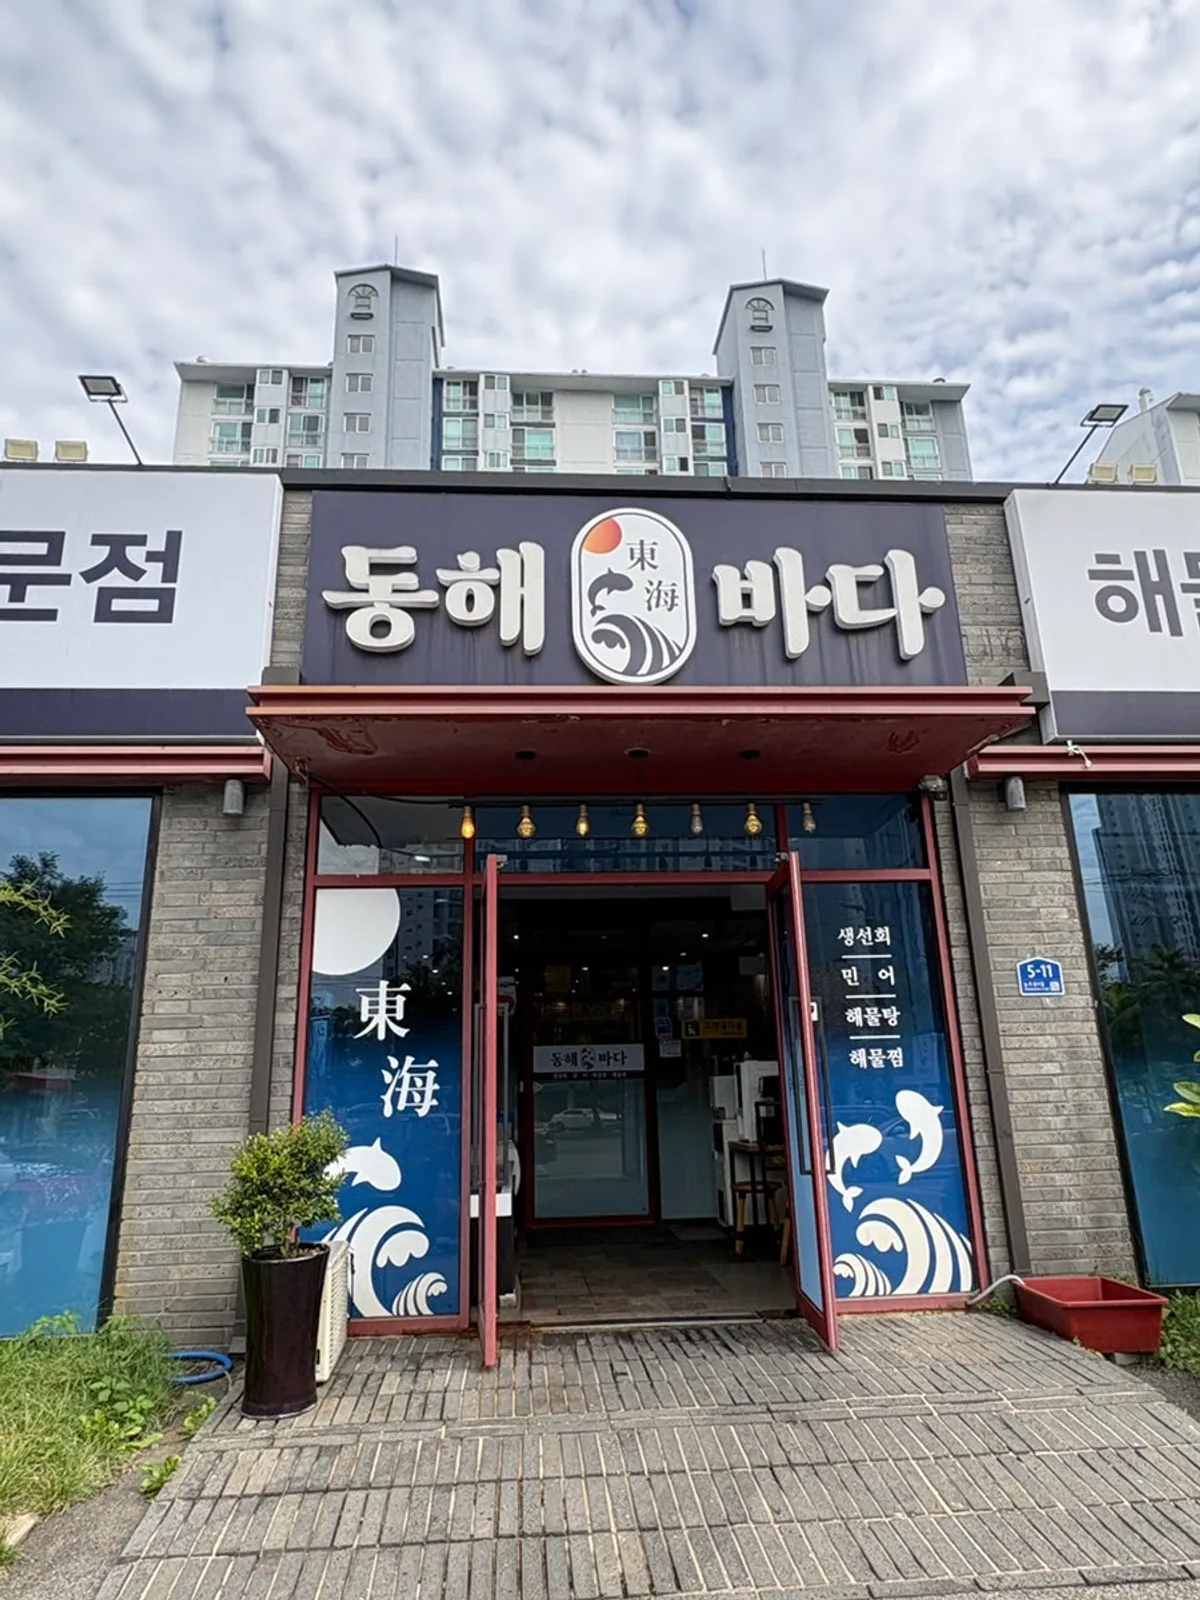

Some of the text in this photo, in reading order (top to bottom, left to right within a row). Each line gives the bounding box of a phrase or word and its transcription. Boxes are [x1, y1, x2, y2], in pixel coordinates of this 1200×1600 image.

[0, 529, 183, 624] 문점
[322, 541, 946, 661] 동해 바다
[837, 926, 892, 946] 생선회
[1027, 964, 1053, 979] 5-11
[845, 1006, 901, 1027] 해물탕
[550, 1050, 628, 1067] 동해 바다
[849, 1047, 904, 1069] 해물찜
